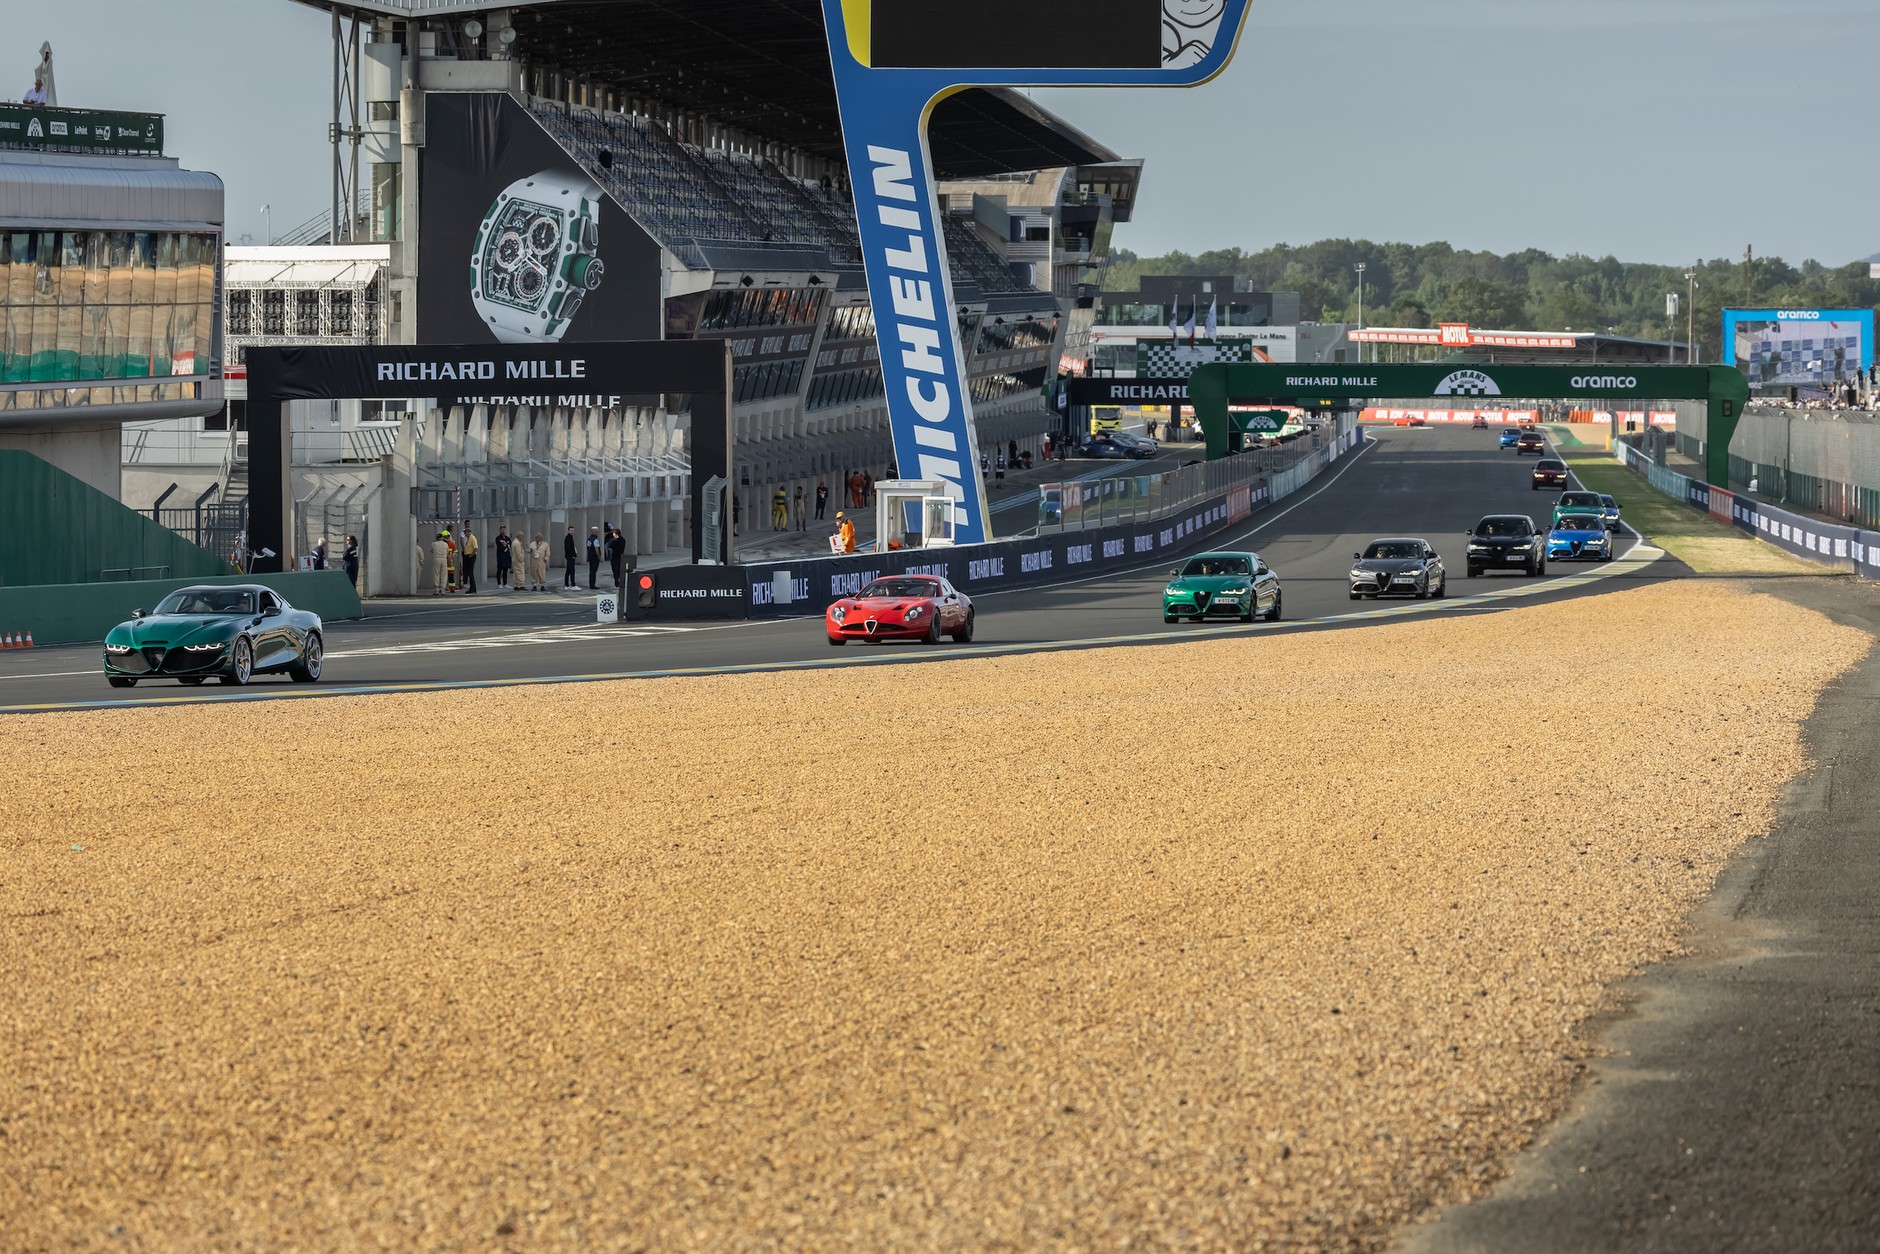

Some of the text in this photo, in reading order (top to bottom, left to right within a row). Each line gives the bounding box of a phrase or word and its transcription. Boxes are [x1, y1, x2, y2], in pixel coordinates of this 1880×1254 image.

[1777, 310, 1820, 320] aramco
[868, 145, 969, 526] MICHELIN
[1442, 326, 1469, 343] MOTUL
[377, 359, 586, 382] RICHARD MILLE
[1286, 377, 1378, 386] RICHARD MILLE
[1571, 376, 1637, 389] aramco
[969, 558, 1004, 580] RICHARD MILLE
[660, 588, 742, 598] RICHARD MILLE
[752, 578, 809, 605] RICHA ILLE
[831, 573, 860, 596] RICHARD
